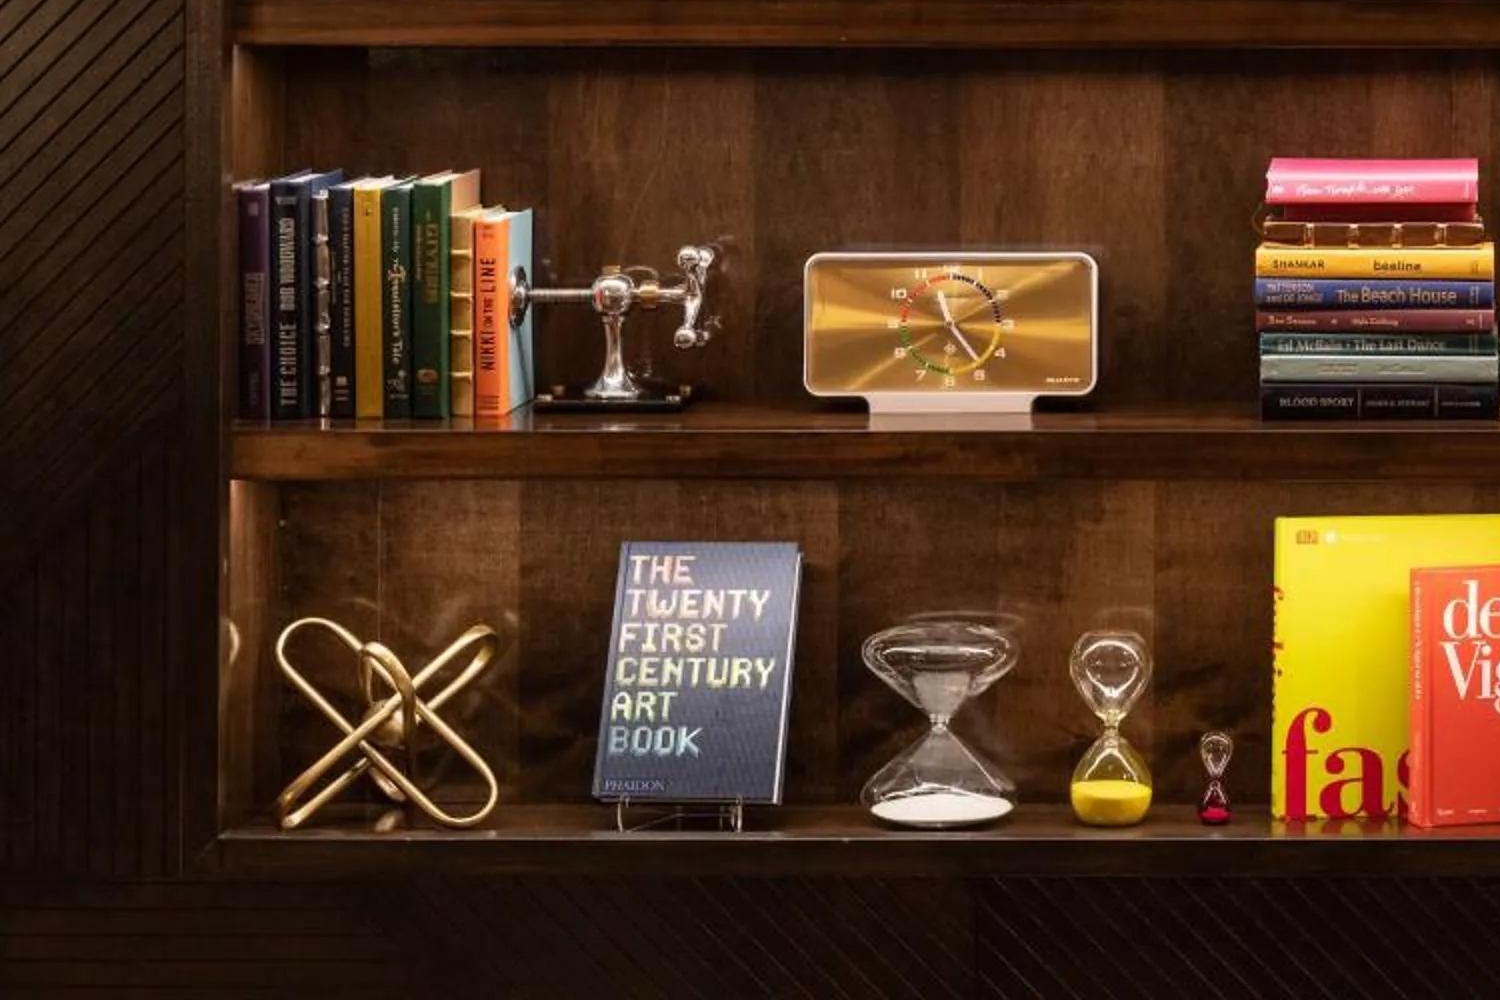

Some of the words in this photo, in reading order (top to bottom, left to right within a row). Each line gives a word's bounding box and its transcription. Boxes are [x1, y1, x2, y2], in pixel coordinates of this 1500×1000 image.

[279, 217, 296, 284] WOODWARD
[1272, 260, 1325, 270] SHANKAR
[1373, 260, 1422, 271] beeline
[480, 257, 496, 293] LINE
[915, 270, 927, 279] 11
[279, 286, 296, 311] BOB
[891, 288, 907, 299] 10
[1337, 289, 1359, 302] The
[1361, 287, 1408, 304] Beach
[1409, 288, 1458, 304] House
[279, 322, 297, 376] CHOICE
[480, 330, 496, 371] NIKKI
[1354, 339, 1377, 351] The
[1378, 339, 1404, 351] Last
[1406, 339, 1447, 351] Dance
[280, 379, 297, 406] THE
[1279, 398, 1317, 407] BLOOD
[629, 555, 696, 585] THE
[625, 589, 772, 621] TWENTY
[618, 623, 729, 653] FIRST
[614, 657, 776, 690] CENTURY
[609, 691, 680, 722] ART
[607, 725, 703, 757] BOOK
[1281, 707, 1410, 822] fa
